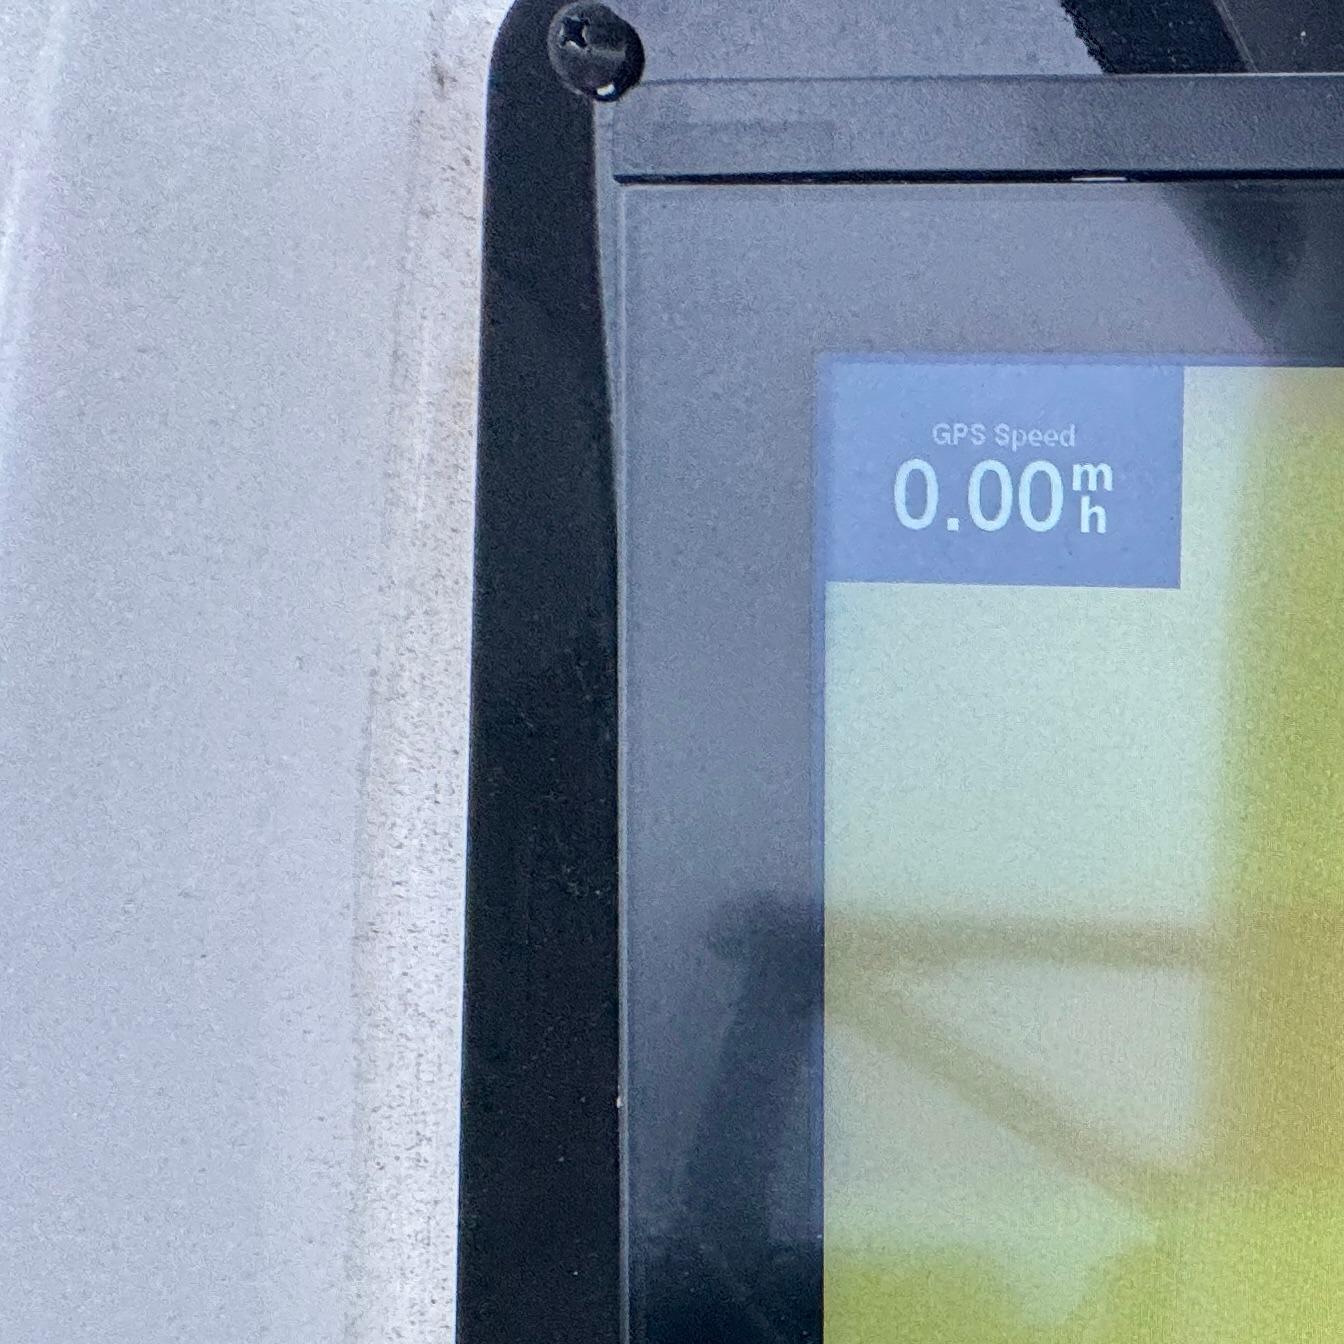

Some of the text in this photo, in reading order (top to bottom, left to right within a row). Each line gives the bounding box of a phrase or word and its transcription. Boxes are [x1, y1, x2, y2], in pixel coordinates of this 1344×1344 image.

[932, 423, 1076, 452] GPS Speed
[893, 458, 1064, 533] 0.00
